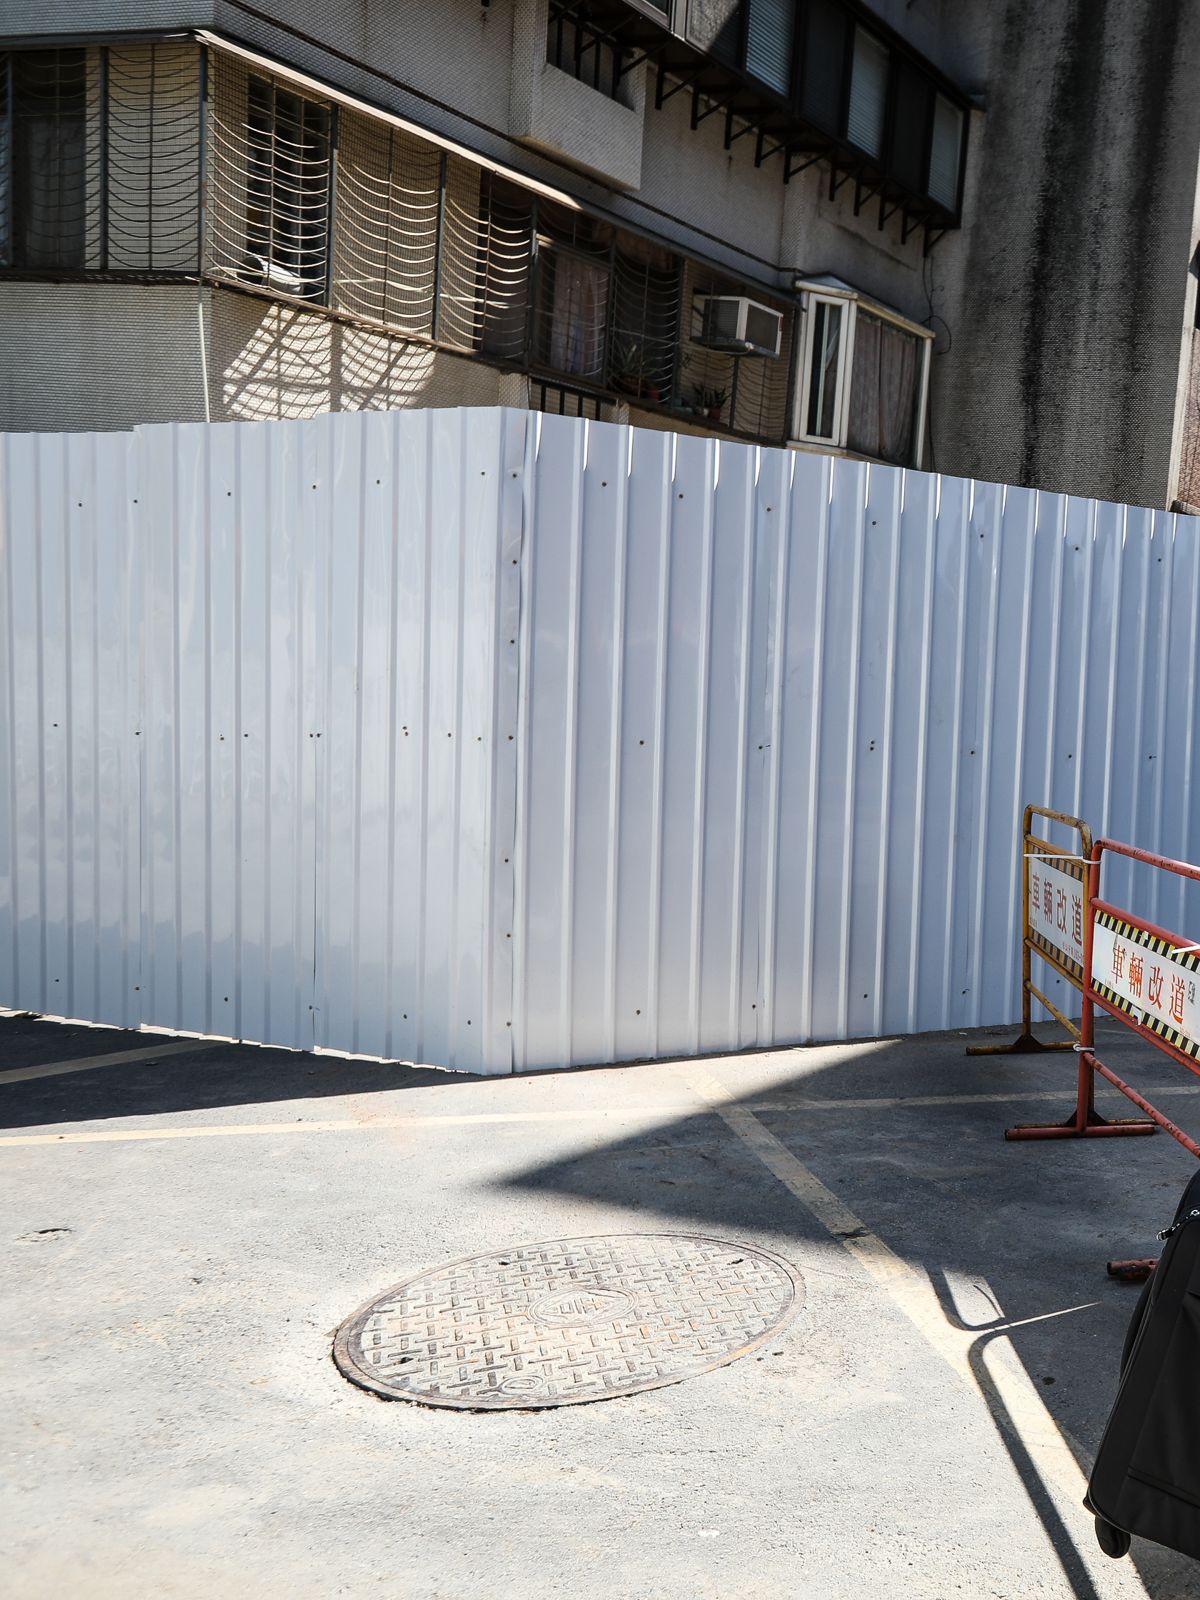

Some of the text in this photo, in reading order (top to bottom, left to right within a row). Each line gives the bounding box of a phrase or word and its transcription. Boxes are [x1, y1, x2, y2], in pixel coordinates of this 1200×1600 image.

[1032, 871, 1083, 946] 車輛改道
[1111, 944, 1186, 1025] 車輛改道
